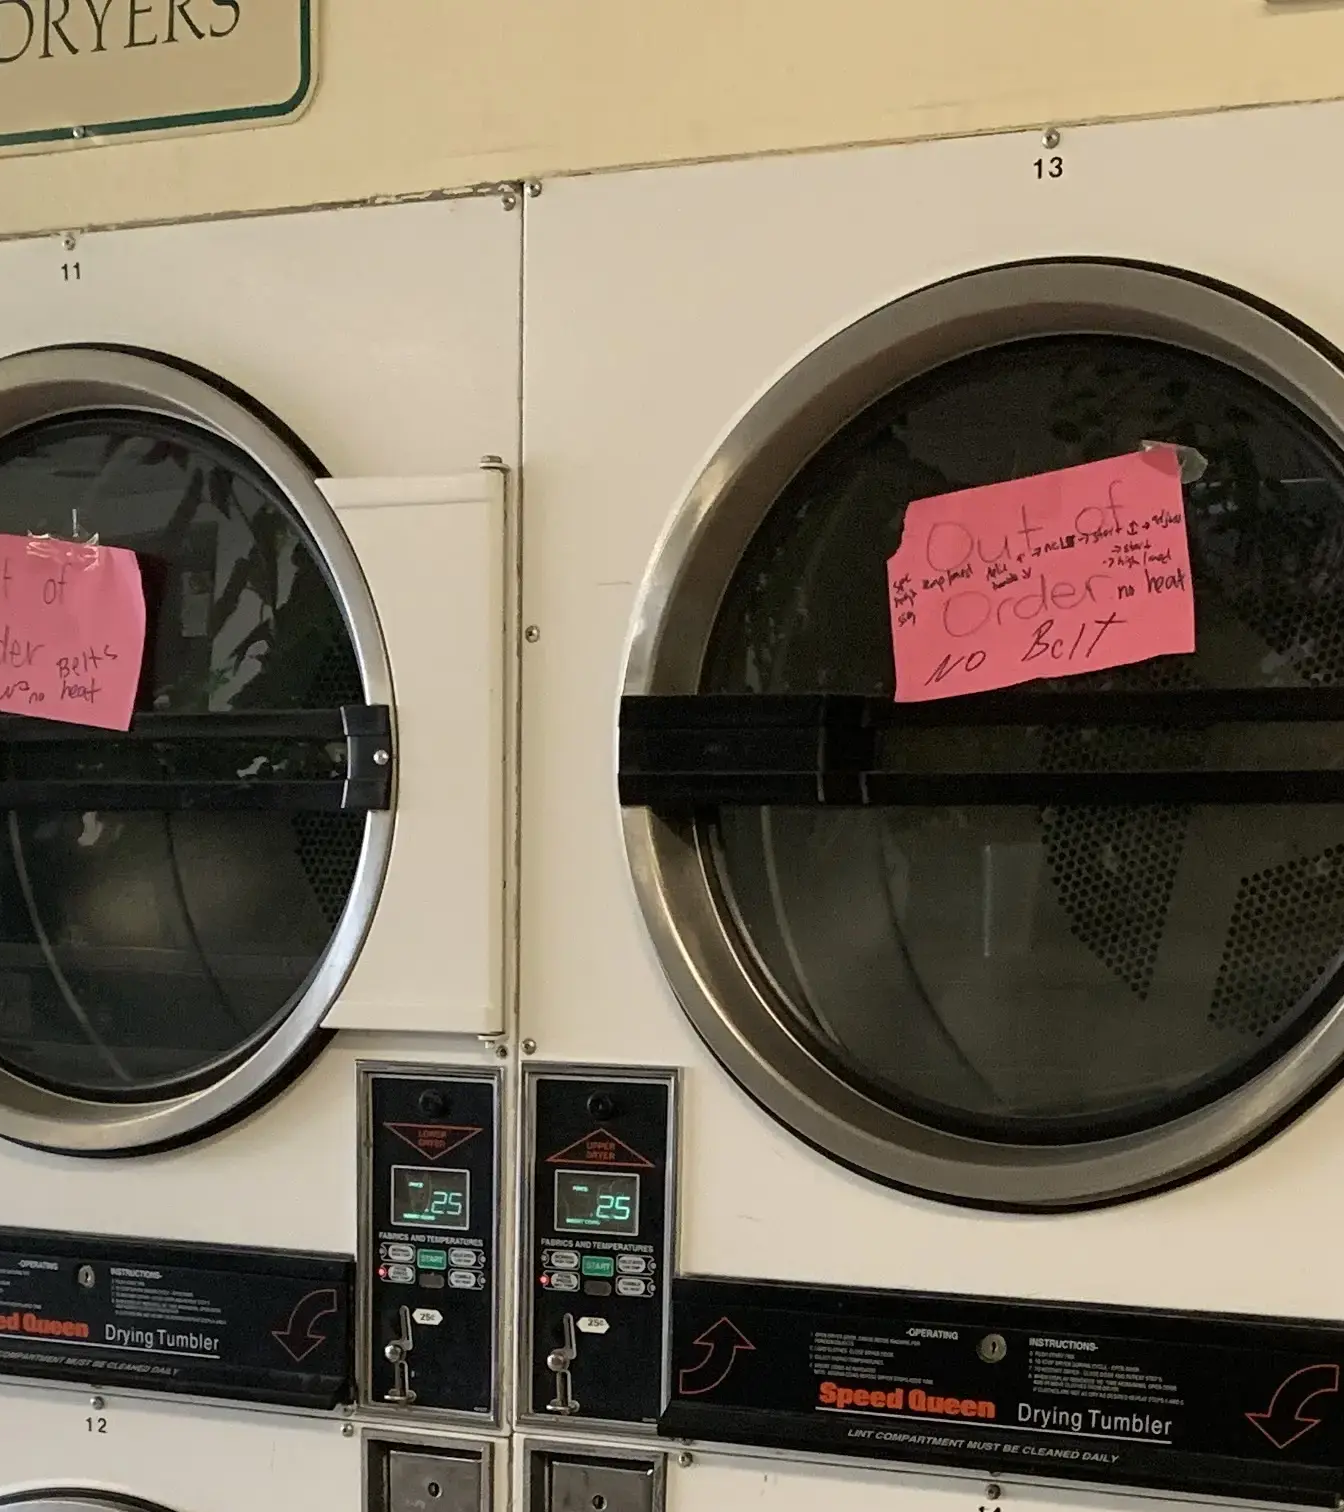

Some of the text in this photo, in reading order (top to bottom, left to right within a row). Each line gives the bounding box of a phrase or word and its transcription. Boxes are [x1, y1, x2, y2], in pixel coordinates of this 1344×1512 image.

[1033, 156, 1063, 179] 13
[60, 262, 82, 282] 11
[927, 480, 1128, 572] Out of
[43, 562, 73, 605] of
[943, 574, 1112, 637] Order
[60, 677, 103, 703] heat
[379, 1232, 484, 1247] FABRICS AND TEMPERATURES
[540, 1237, 654, 1253] FABRICS AND TEMPERATURES
[22, 1313, 89, 1338] Queen
[105, 1324, 219, 1350] Drying Tumbler
[819, 1381, 996, 1419] Speed Queen
[86, 1417, 108, 1434] 12
[1017, 1402, 1172, 1435] Drying Tumbler
[848, 1429, 1119, 1464] LINT COMPARTMENT MUST BE CLEANED DAILY
